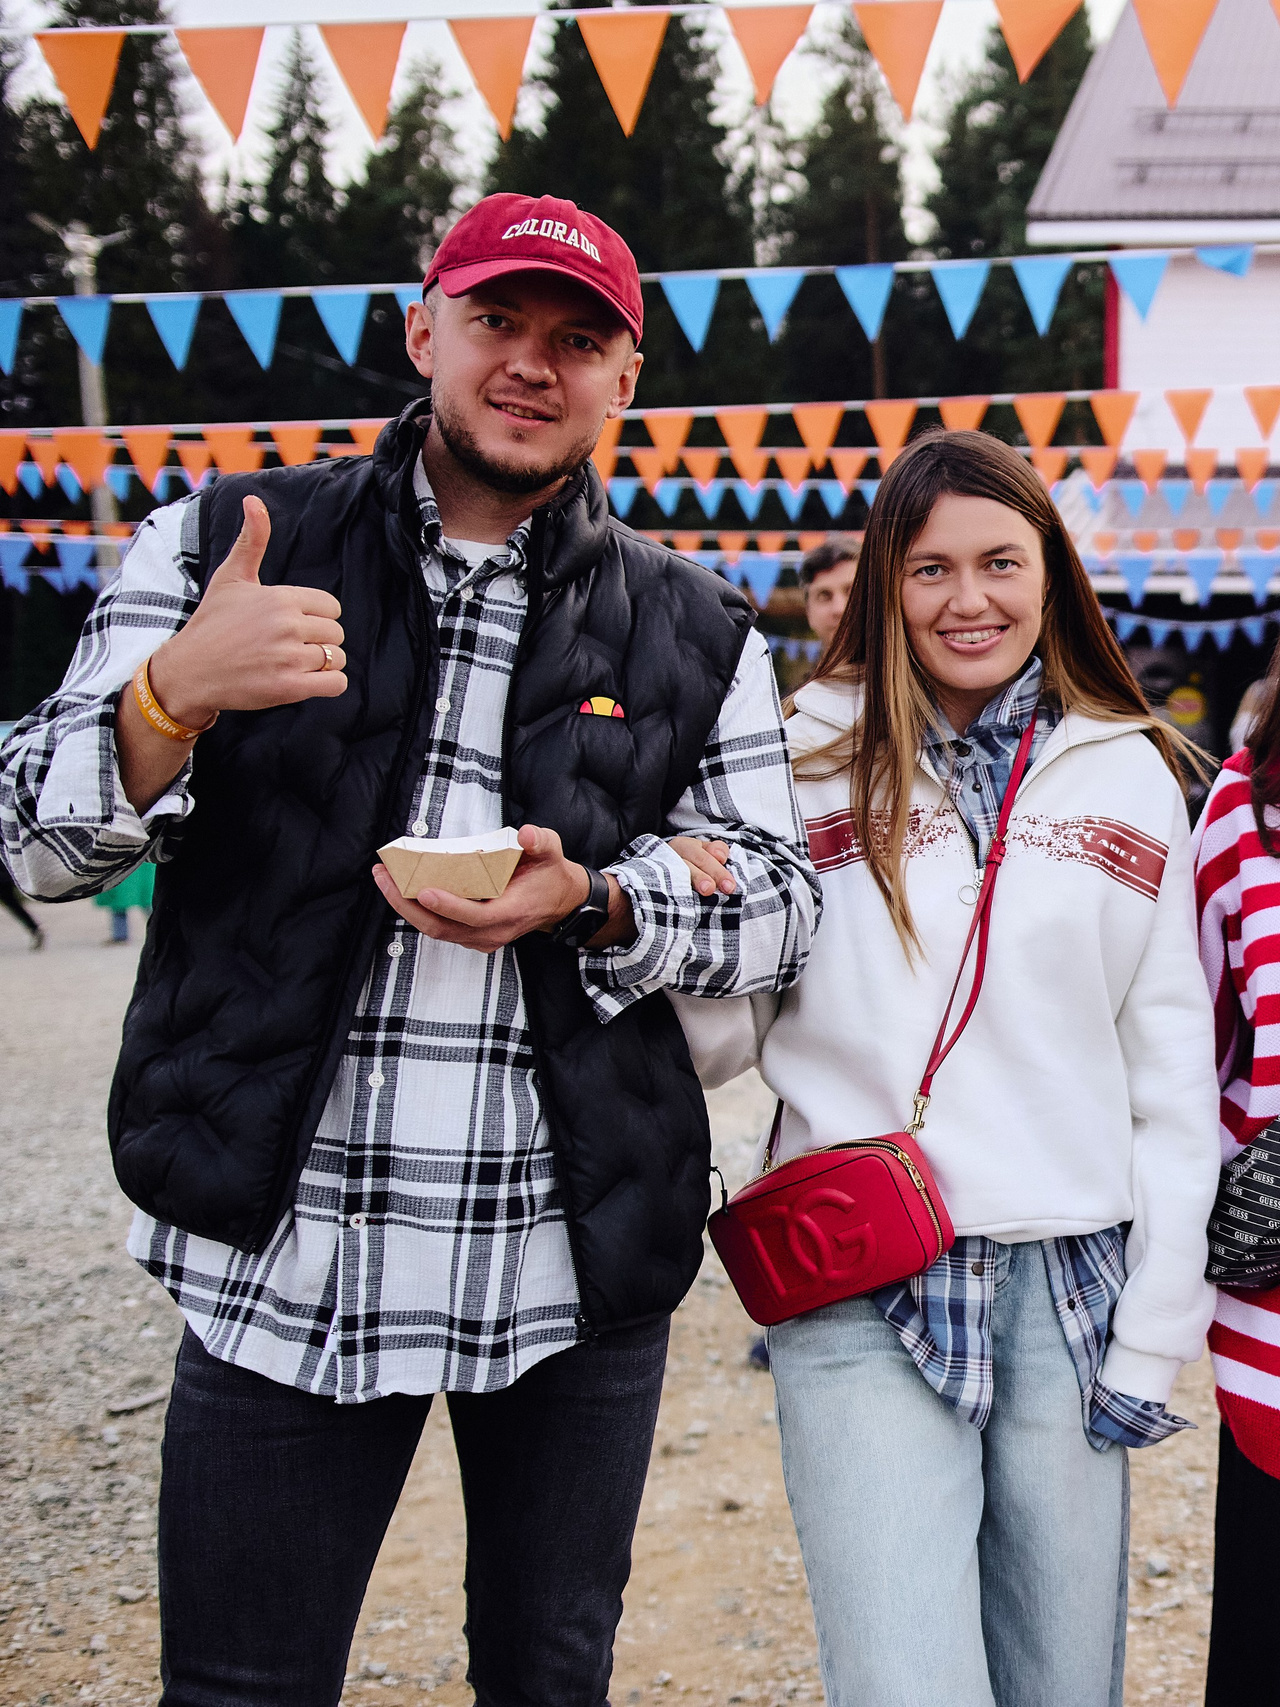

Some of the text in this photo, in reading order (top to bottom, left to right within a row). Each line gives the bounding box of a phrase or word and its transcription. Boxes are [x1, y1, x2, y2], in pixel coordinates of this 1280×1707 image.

[501, 218, 601, 263] COLORADO
[1251, 1149, 1269, 1160] GUESS
[1253, 1171, 1275, 1185] GUESS
[1228, 1207, 1249, 1220] GUESS
[1234, 1230, 1259, 1245] GUESS
